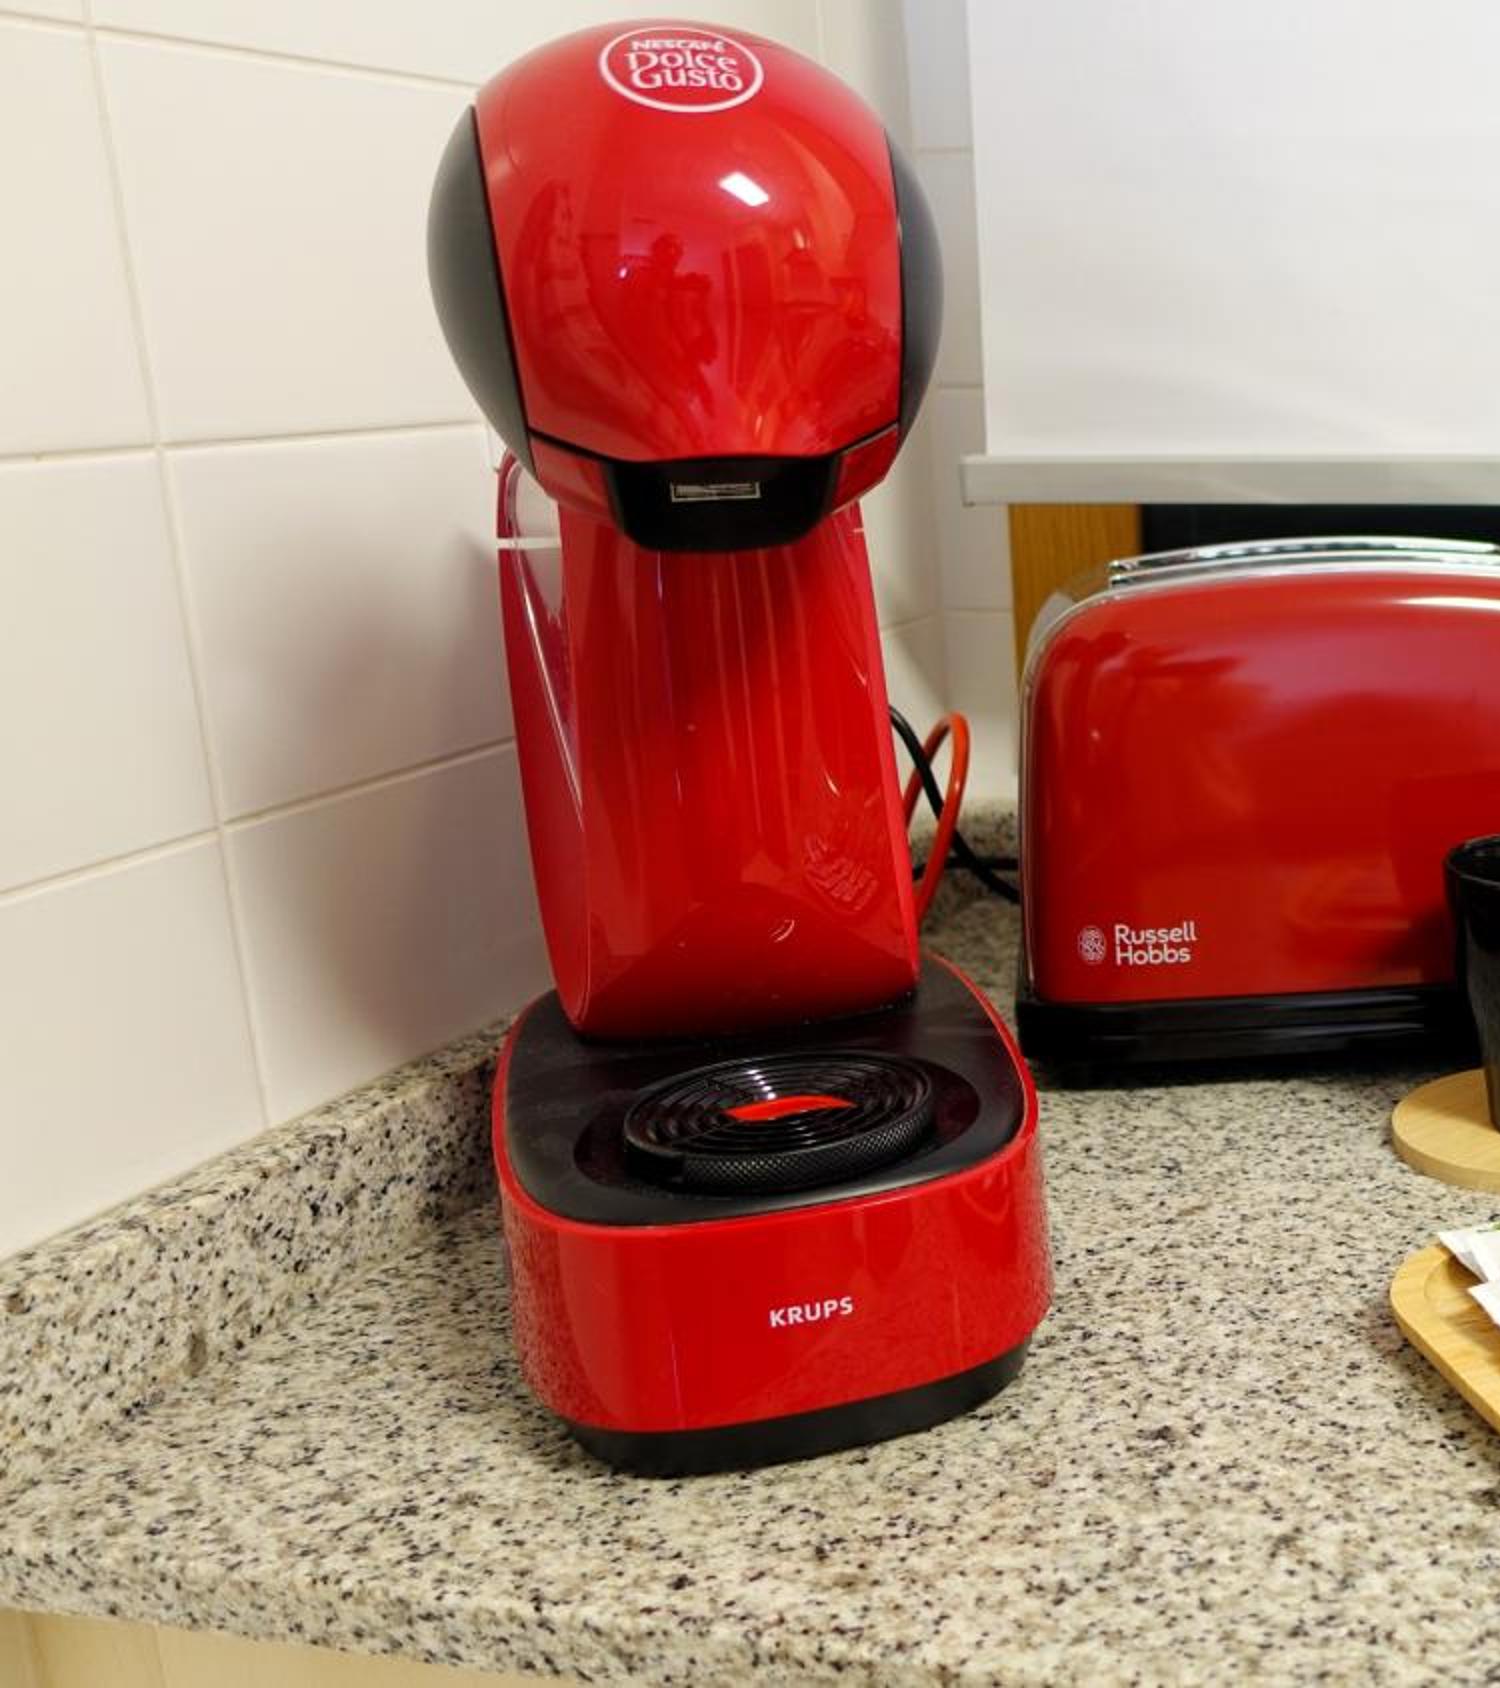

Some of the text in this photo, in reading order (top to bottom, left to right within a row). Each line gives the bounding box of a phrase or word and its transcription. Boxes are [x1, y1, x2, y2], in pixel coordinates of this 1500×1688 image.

[624, 49, 738, 71] Dolce
[631, 66, 744, 91] Gusto
[1114, 920, 1197, 945] Russell
[1115, 943, 1191, 966] Hobbs
[768, 1296, 853, 1328] KRUPS
